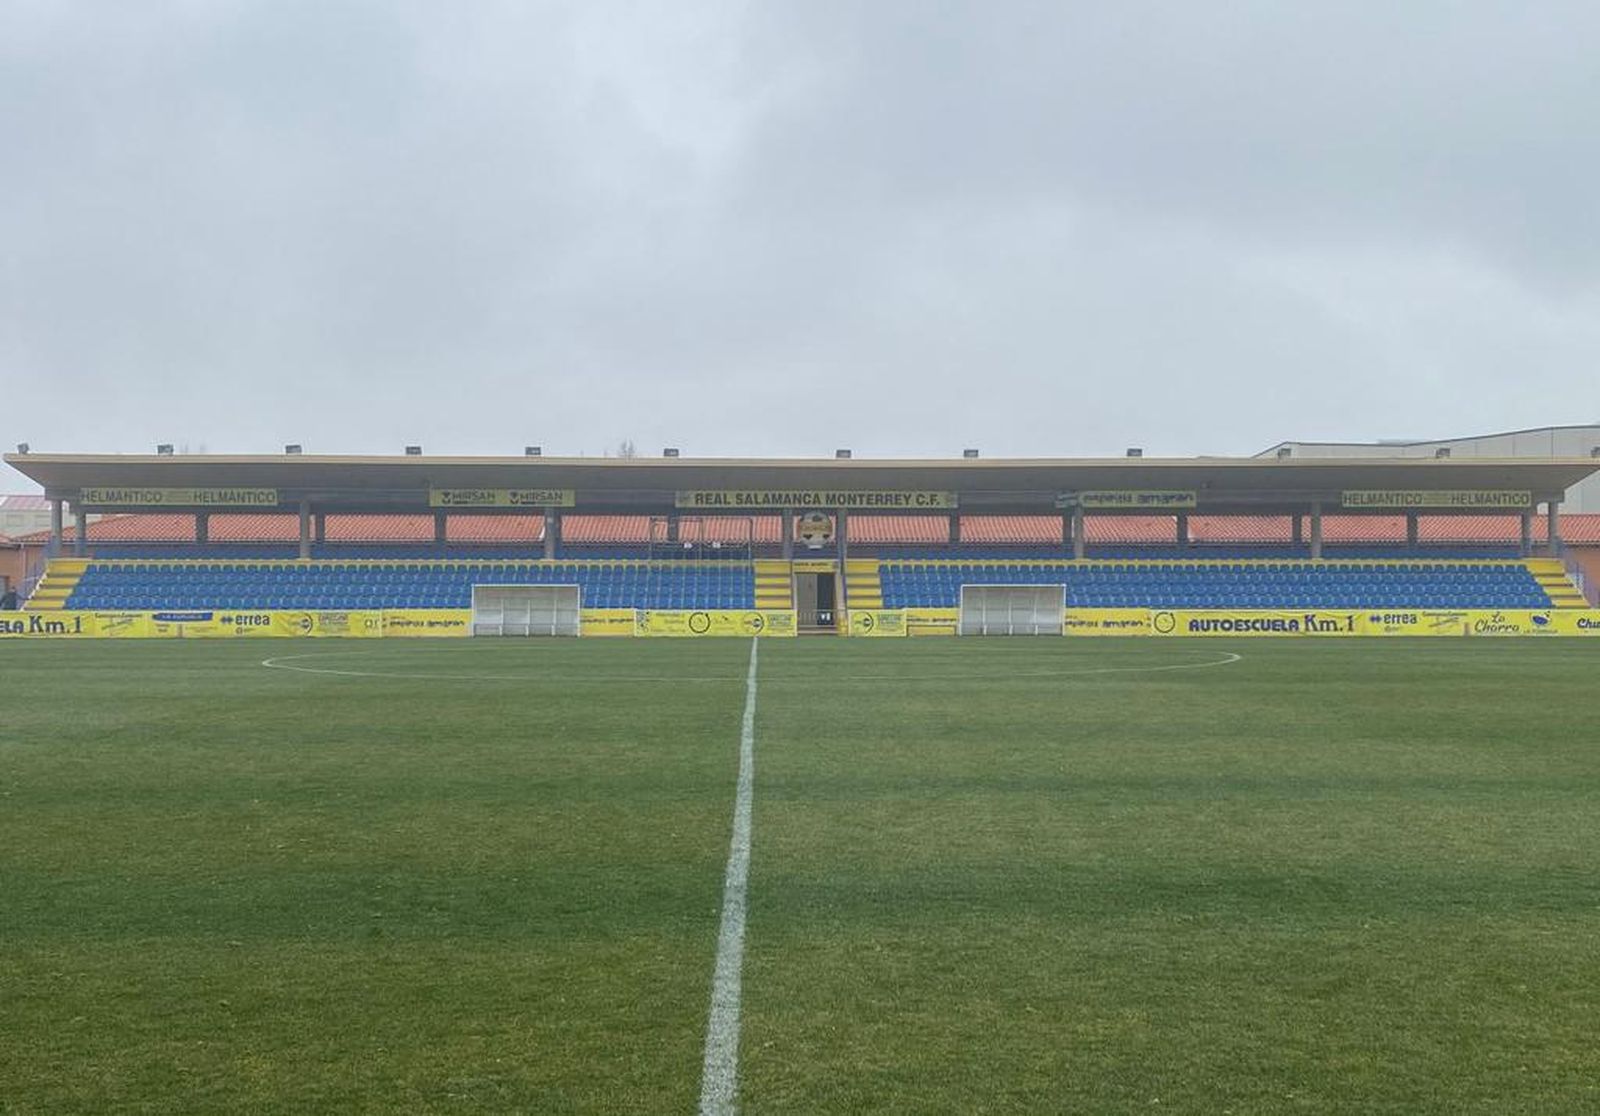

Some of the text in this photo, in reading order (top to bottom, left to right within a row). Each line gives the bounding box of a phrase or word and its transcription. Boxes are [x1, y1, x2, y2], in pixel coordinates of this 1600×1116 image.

[695, 493, 940, 505] REAL SALAMANCA MONTERREY C.F.
[235, 614, 270, 626] errea
[1189, 618, 1300, 632] AUTOESCUELA
[1383, 613, 1418, 625] errea
